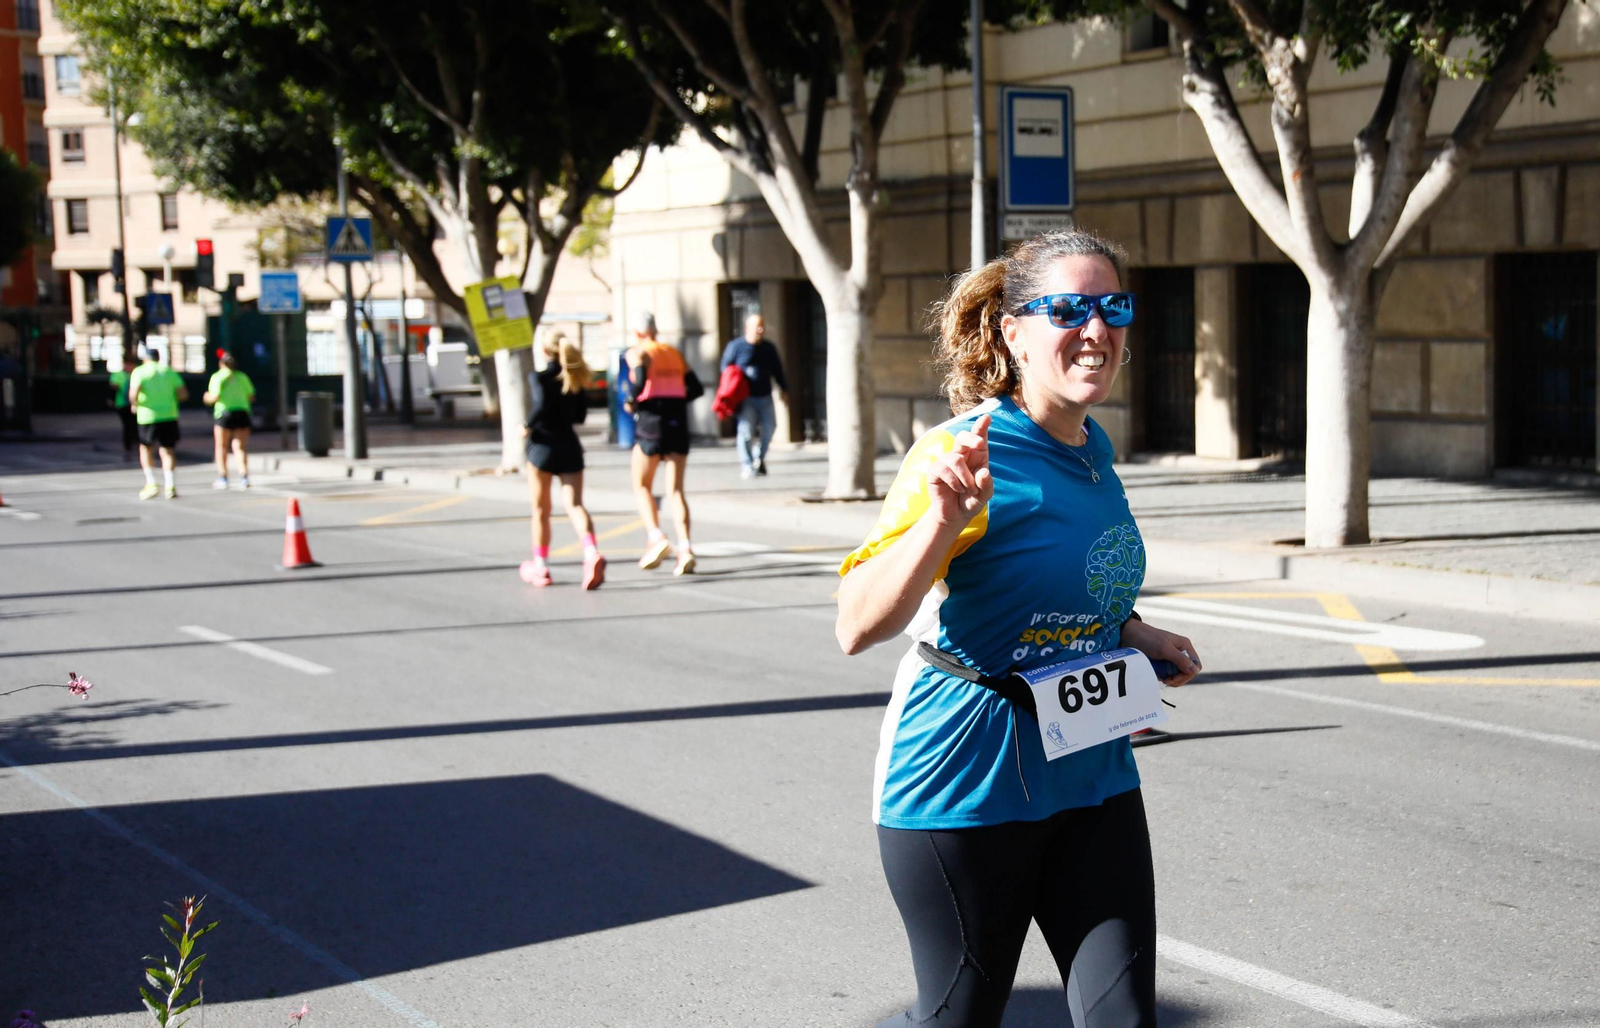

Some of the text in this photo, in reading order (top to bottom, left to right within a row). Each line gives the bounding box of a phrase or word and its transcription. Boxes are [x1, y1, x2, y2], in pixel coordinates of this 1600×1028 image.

[1058, 660, 1127, 714] 697
[1119, 718, 1138, 729] febrero
[1145, 711, 1158, 720] 2025
